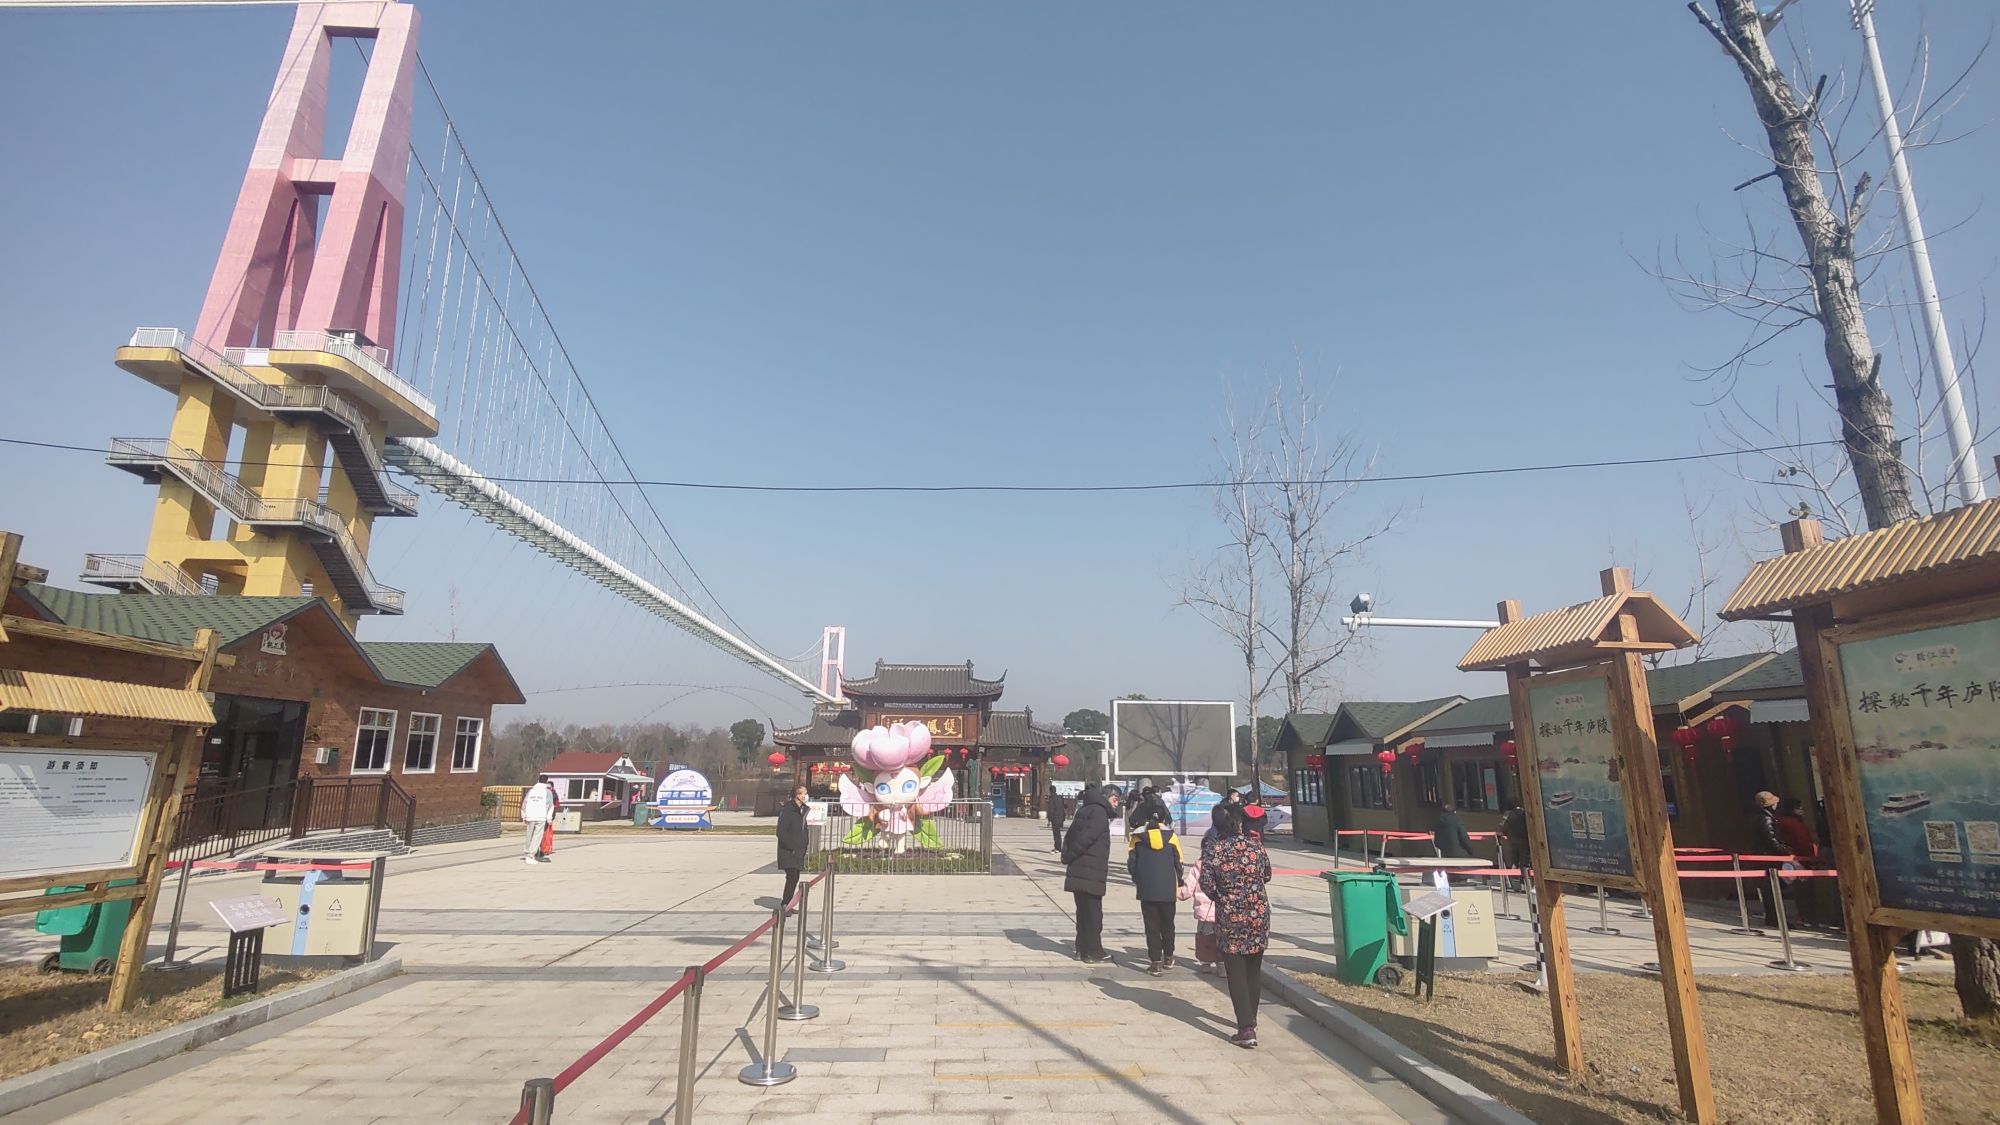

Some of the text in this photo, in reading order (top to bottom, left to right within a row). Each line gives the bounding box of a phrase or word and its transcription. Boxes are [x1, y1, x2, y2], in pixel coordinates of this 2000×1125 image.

[1539, 715, 1612, 738] 探秘千年庐陵
[46, 760, 98, 770] 游客须知
